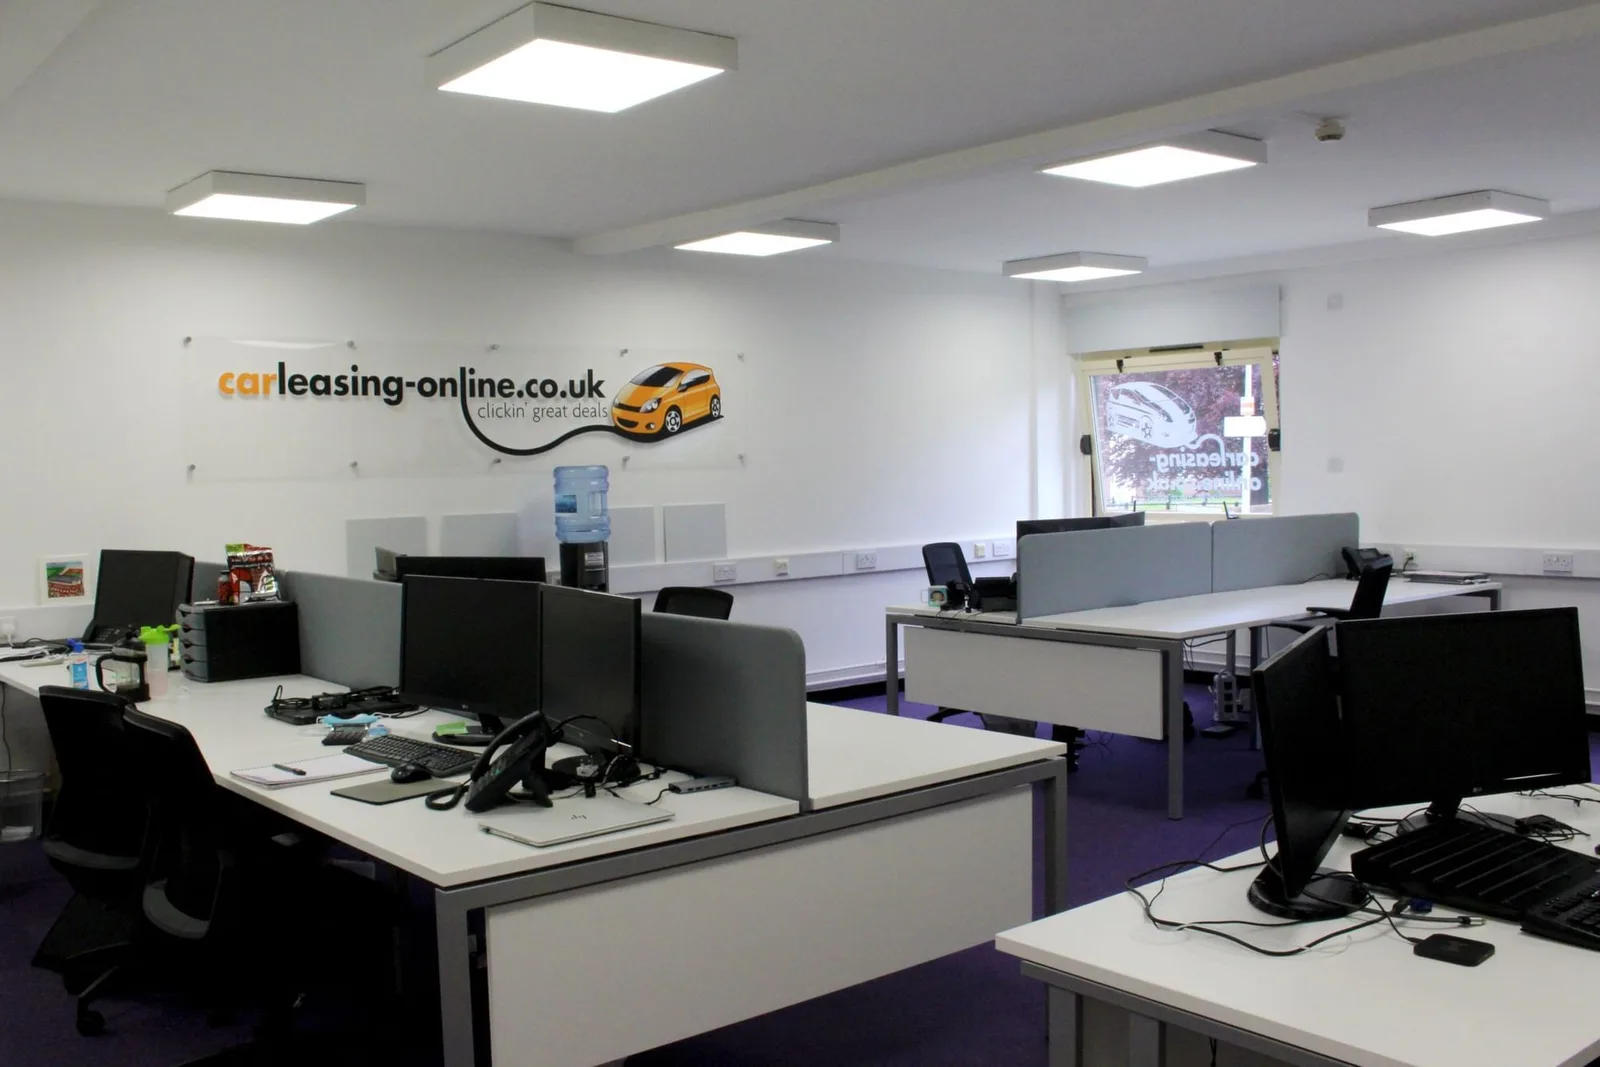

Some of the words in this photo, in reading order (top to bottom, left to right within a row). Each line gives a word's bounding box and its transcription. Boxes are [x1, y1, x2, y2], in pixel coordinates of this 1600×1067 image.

[218, 361, 606, 406] carleasing-online.co.uk
[477, 401, 528, 419] clickin'
[532, 404, 569, 423] great
[572, 401, 609, 419] deals
